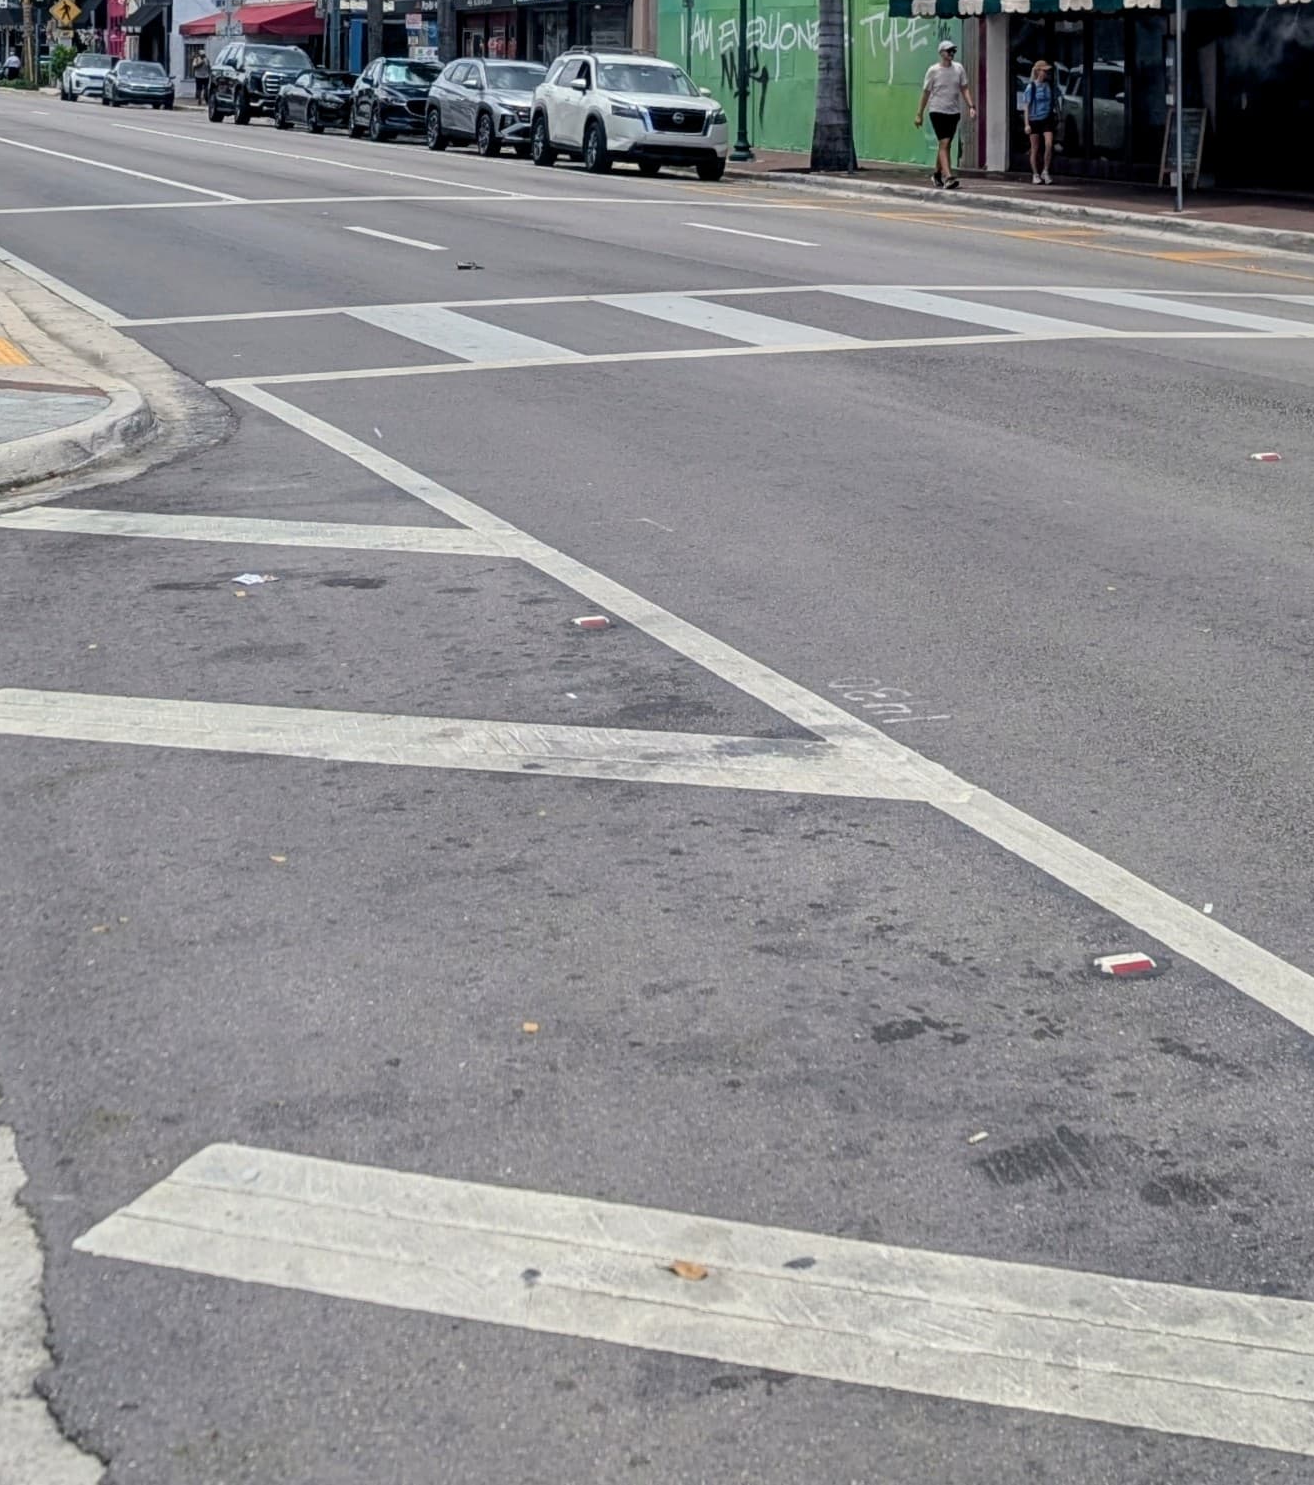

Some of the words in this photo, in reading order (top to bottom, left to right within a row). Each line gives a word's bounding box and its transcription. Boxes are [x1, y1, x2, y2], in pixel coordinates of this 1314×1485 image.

[691, 12, 715, 61] AM
[718, 11, 851, 82] EVERYONE
[860, 12, 931, 84] TYPE
